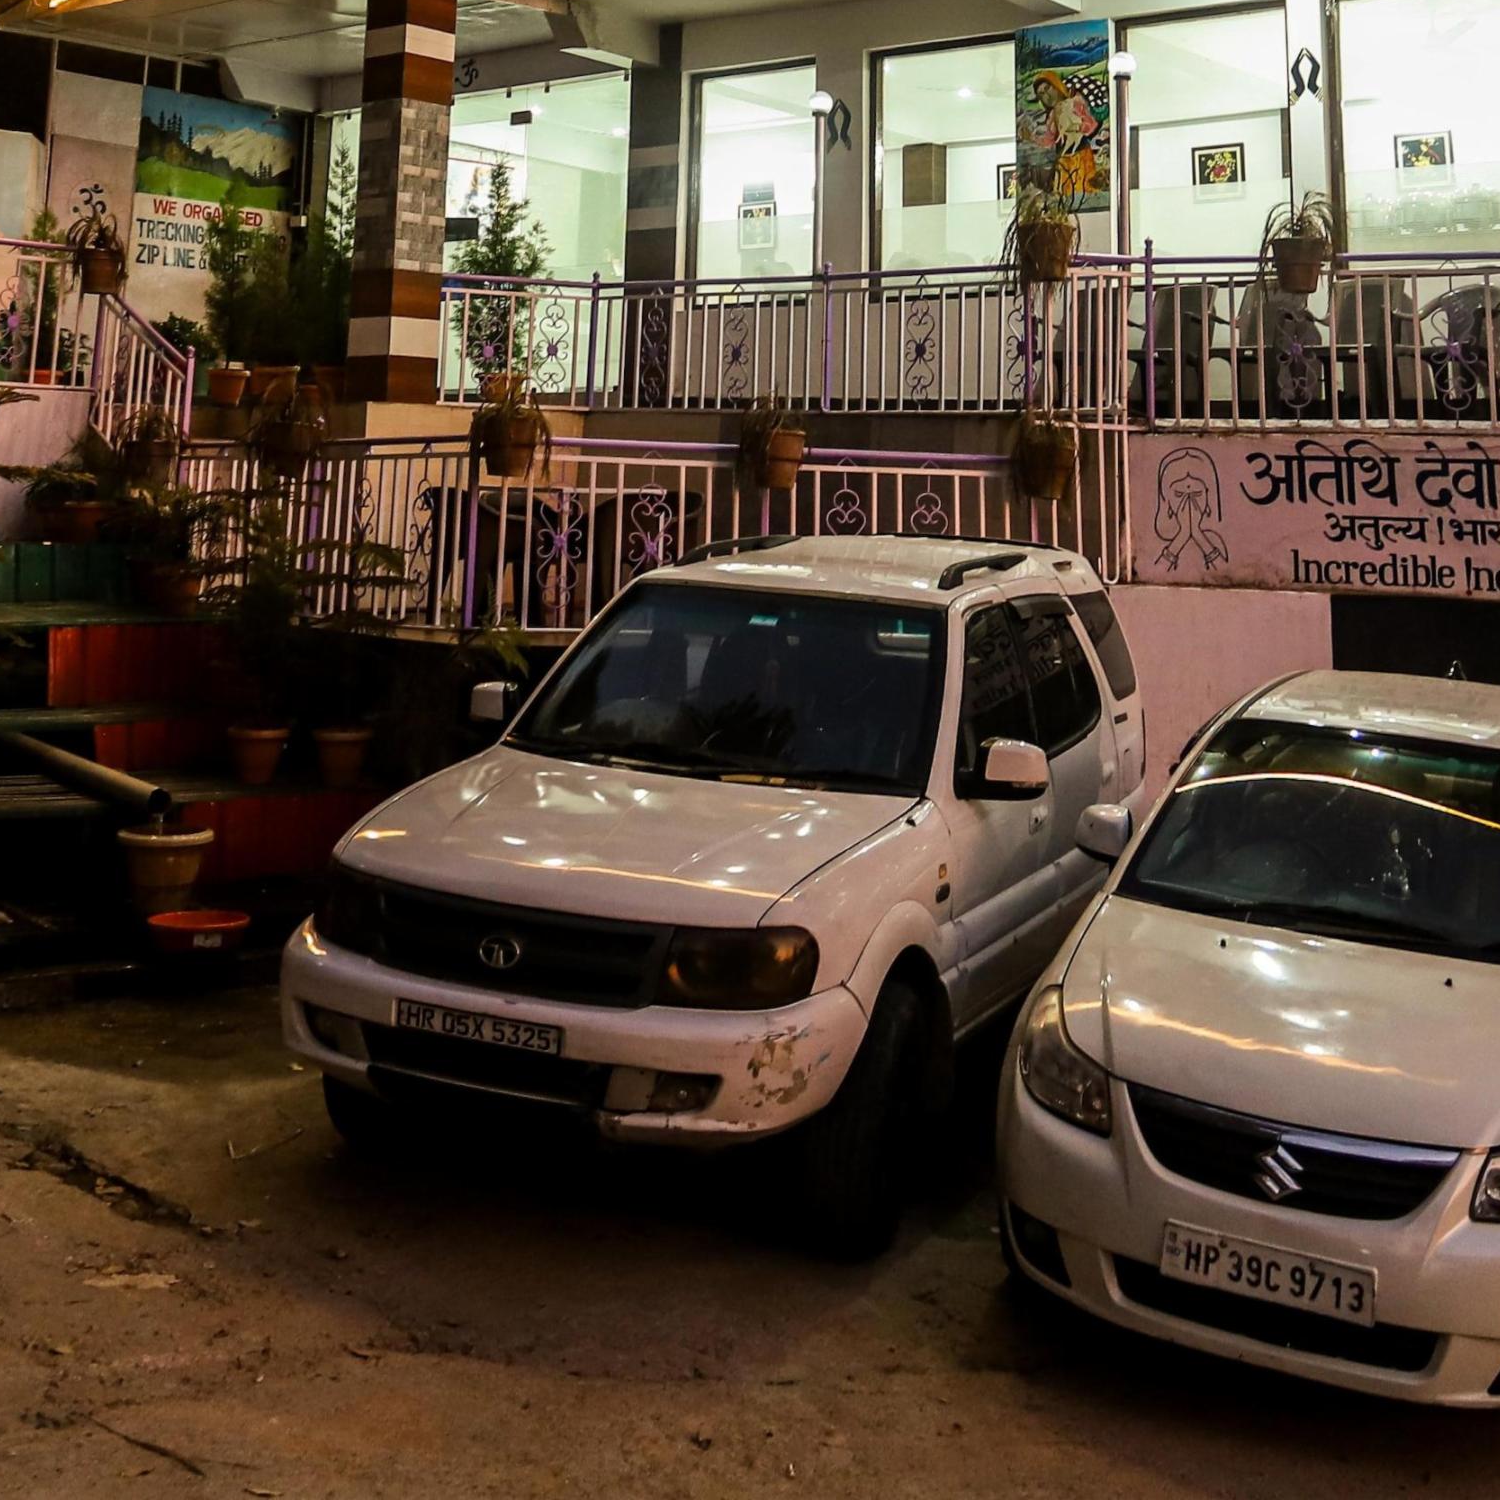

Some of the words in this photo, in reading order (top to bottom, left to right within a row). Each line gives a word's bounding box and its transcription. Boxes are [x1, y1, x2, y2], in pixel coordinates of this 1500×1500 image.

[153, 198, 177, 216] WE
[182, 202, 264, 228] ORGASED
[135, 243, 160, 265] ZIP
[1239, 438, 1401, 507] अतिथि
[1290, 548, 1456, 589] Incredible
[406, 1005, 435, 1029] HR
[441, 1011, 485, 1039] 05X
[491, 1020, 551, 1051] 5325
[1184, 1239, 1220, 1275] HP
[1227, 1250, 1281, 1292] 39C
[1289, 1263, 1365, 1313] 9713
